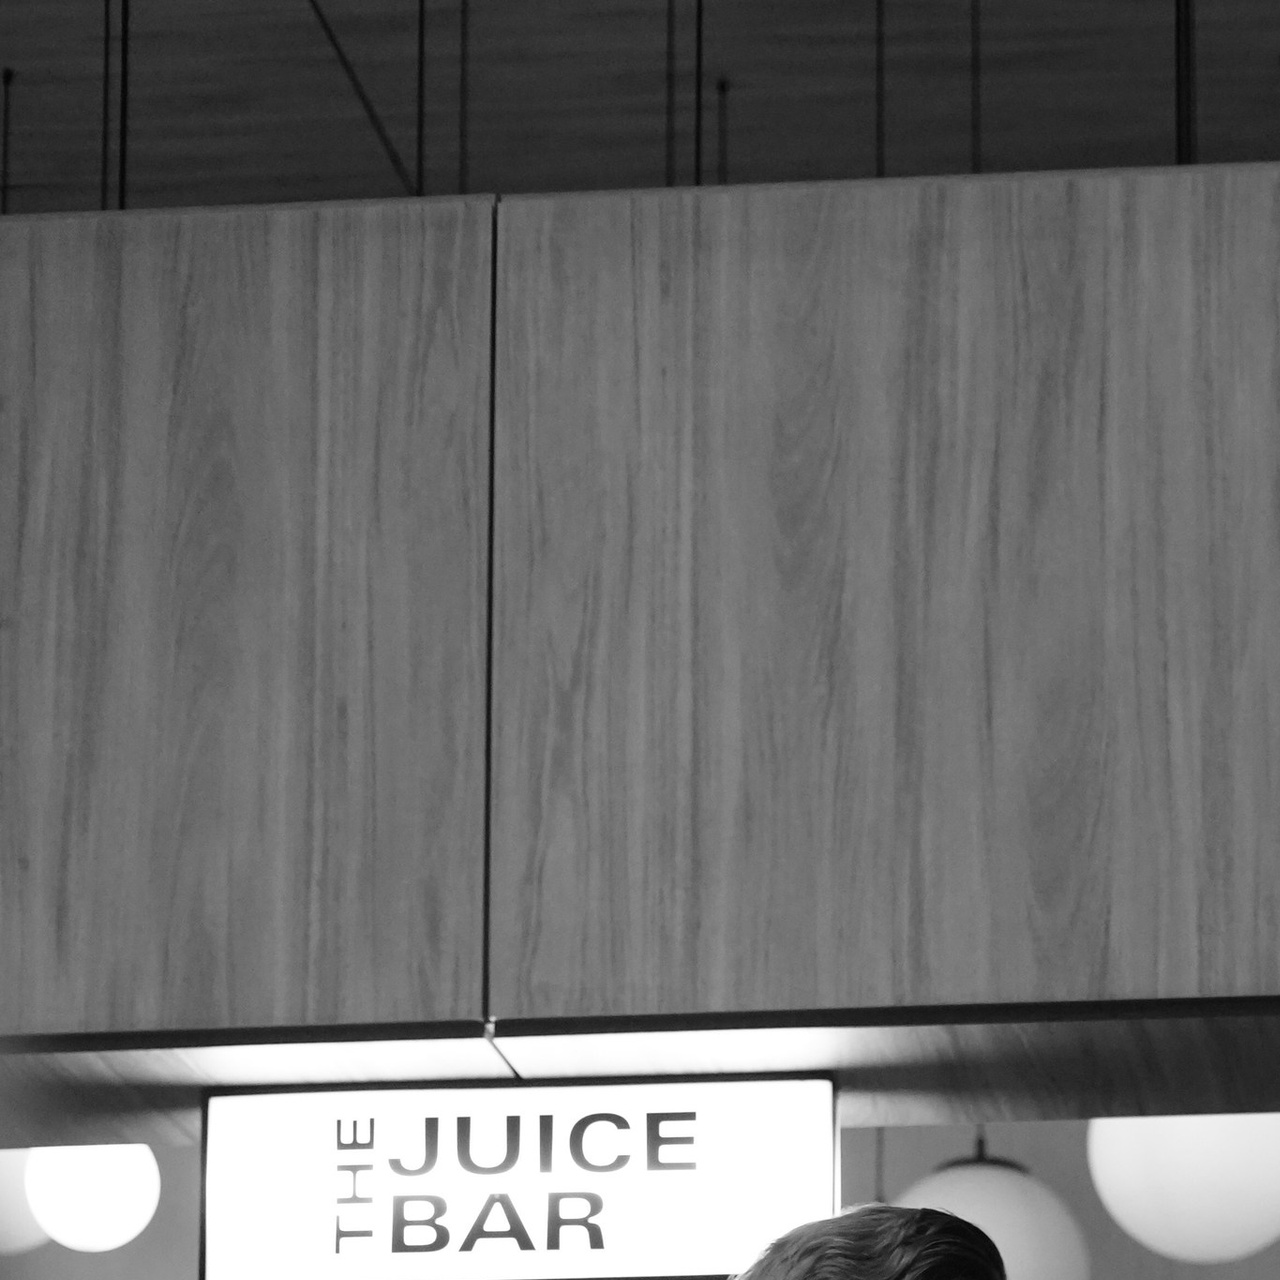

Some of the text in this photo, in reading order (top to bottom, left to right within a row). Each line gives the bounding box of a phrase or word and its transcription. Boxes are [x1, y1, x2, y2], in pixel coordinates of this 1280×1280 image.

[388, 1111, 697, 1176] JUICE
[335, 1117, 375, 1254] THE
[391, 1192, 605, 1253] BAR
